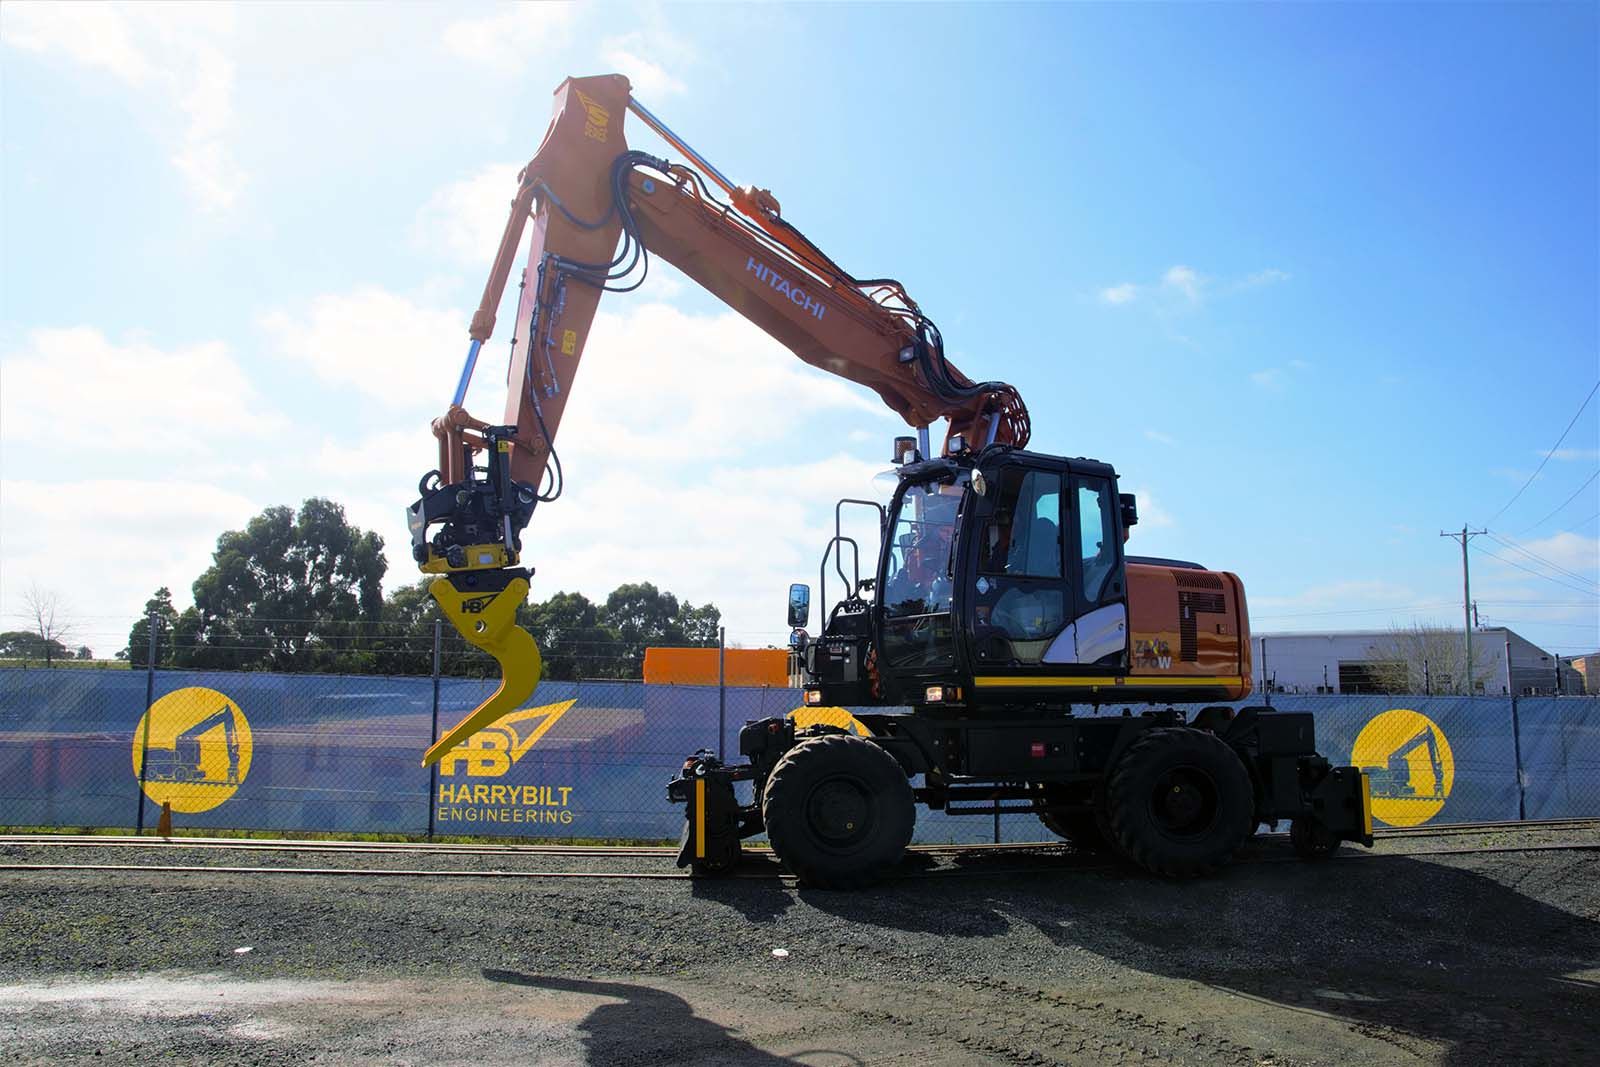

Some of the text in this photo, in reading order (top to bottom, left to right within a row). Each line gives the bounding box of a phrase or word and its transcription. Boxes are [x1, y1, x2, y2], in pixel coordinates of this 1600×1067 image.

[746, 256, 826, 321] HITACHI
[439, 784, 573, 806] HARRYBILT
[438, 807, 573, 824] ENGINEERING
